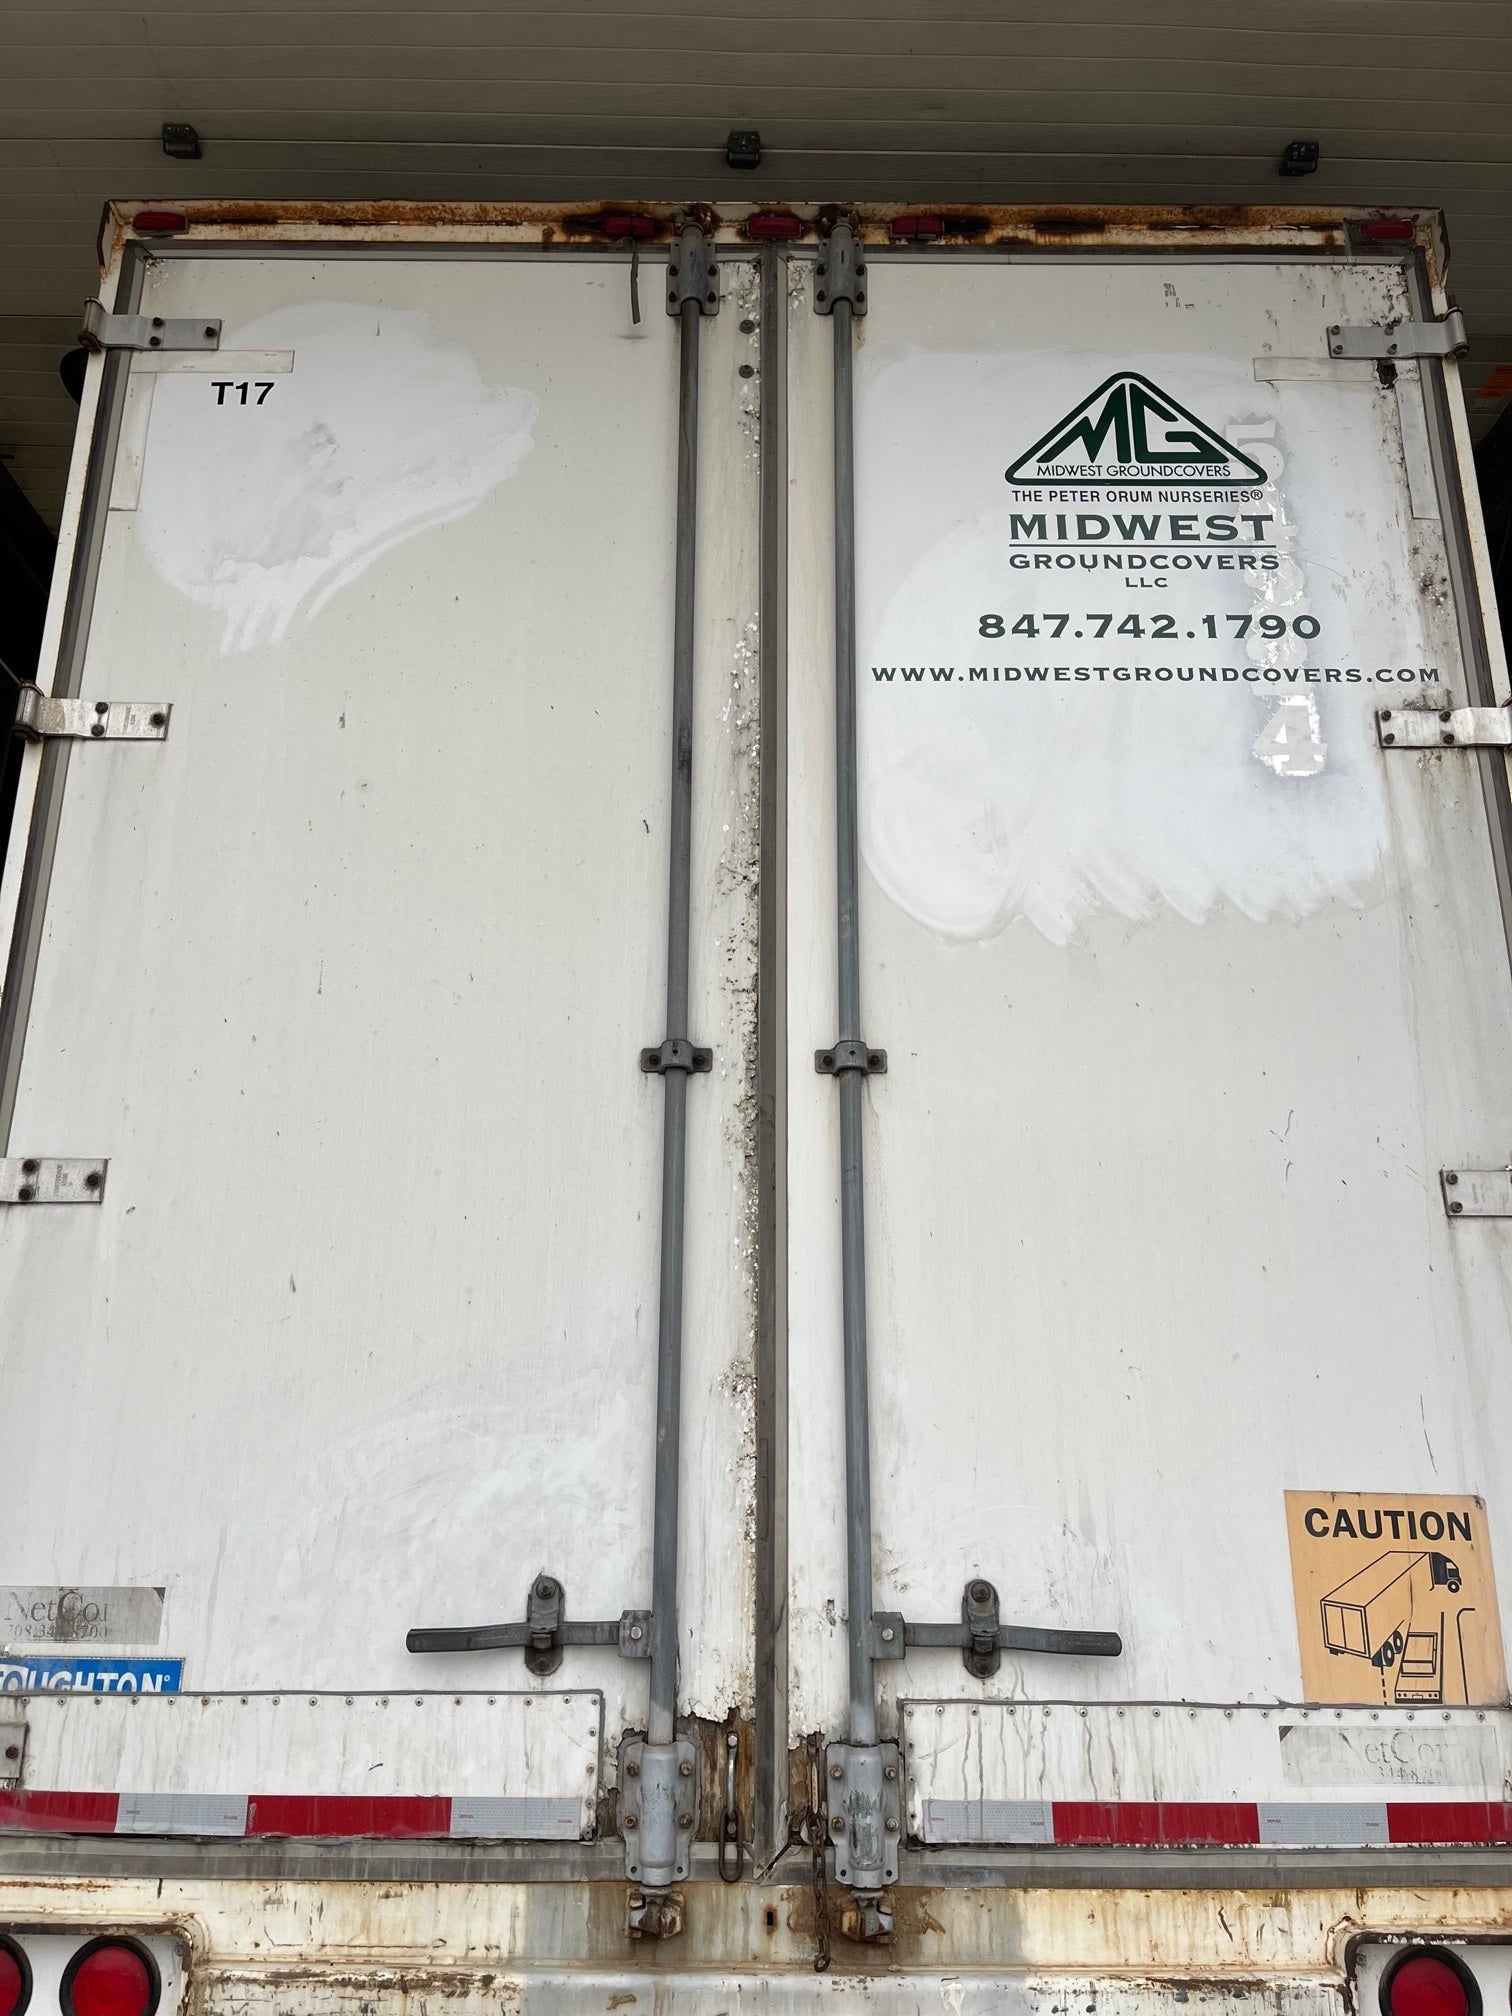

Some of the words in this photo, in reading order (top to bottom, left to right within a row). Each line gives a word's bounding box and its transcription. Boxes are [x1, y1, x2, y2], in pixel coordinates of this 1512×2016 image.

[211, 381, 275, 405] T17
[1037, 465, 1102, 477] MIDWEST
[1106, 465, 1231, 477] GROUNDCOVERS
[1012, 490, 1042, 502] THE
[1049, 490, 1100, 502] PETER
[1106, 490, 1153, 502] ORUM
[1009, 514, 1274, 541] MIDWEST
[1009, 554, 1280, 570] GROUNDCOVERS
[1125, 577, 1168, 588] LLC
[978, 613, 1321, 640] 847.742.1790
[871, 667, 1440, 684] WWW.MIDWESTGROUNDCOVERS.COM
[1304, 1508, 1472, 1541] CAUTION
[0, 1669, 163, 1692] OUGHTON
